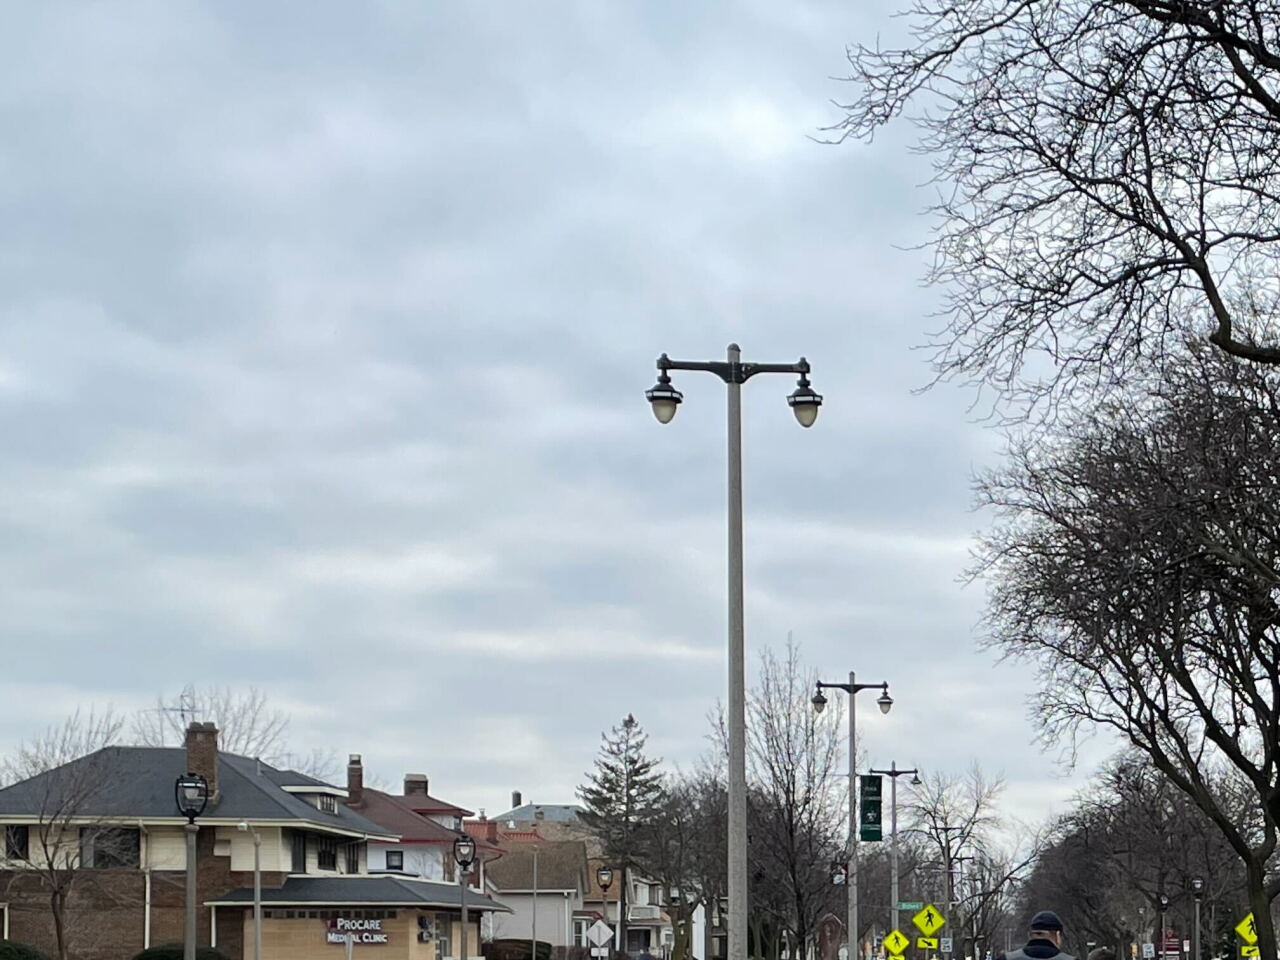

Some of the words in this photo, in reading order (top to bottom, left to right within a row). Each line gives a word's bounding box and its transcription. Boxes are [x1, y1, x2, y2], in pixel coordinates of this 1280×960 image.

[336, 918, 381, 930] PROCARE
[327, 932, 361, 942] MEDIAL
[362, 932, 388, 942] CLINIC
